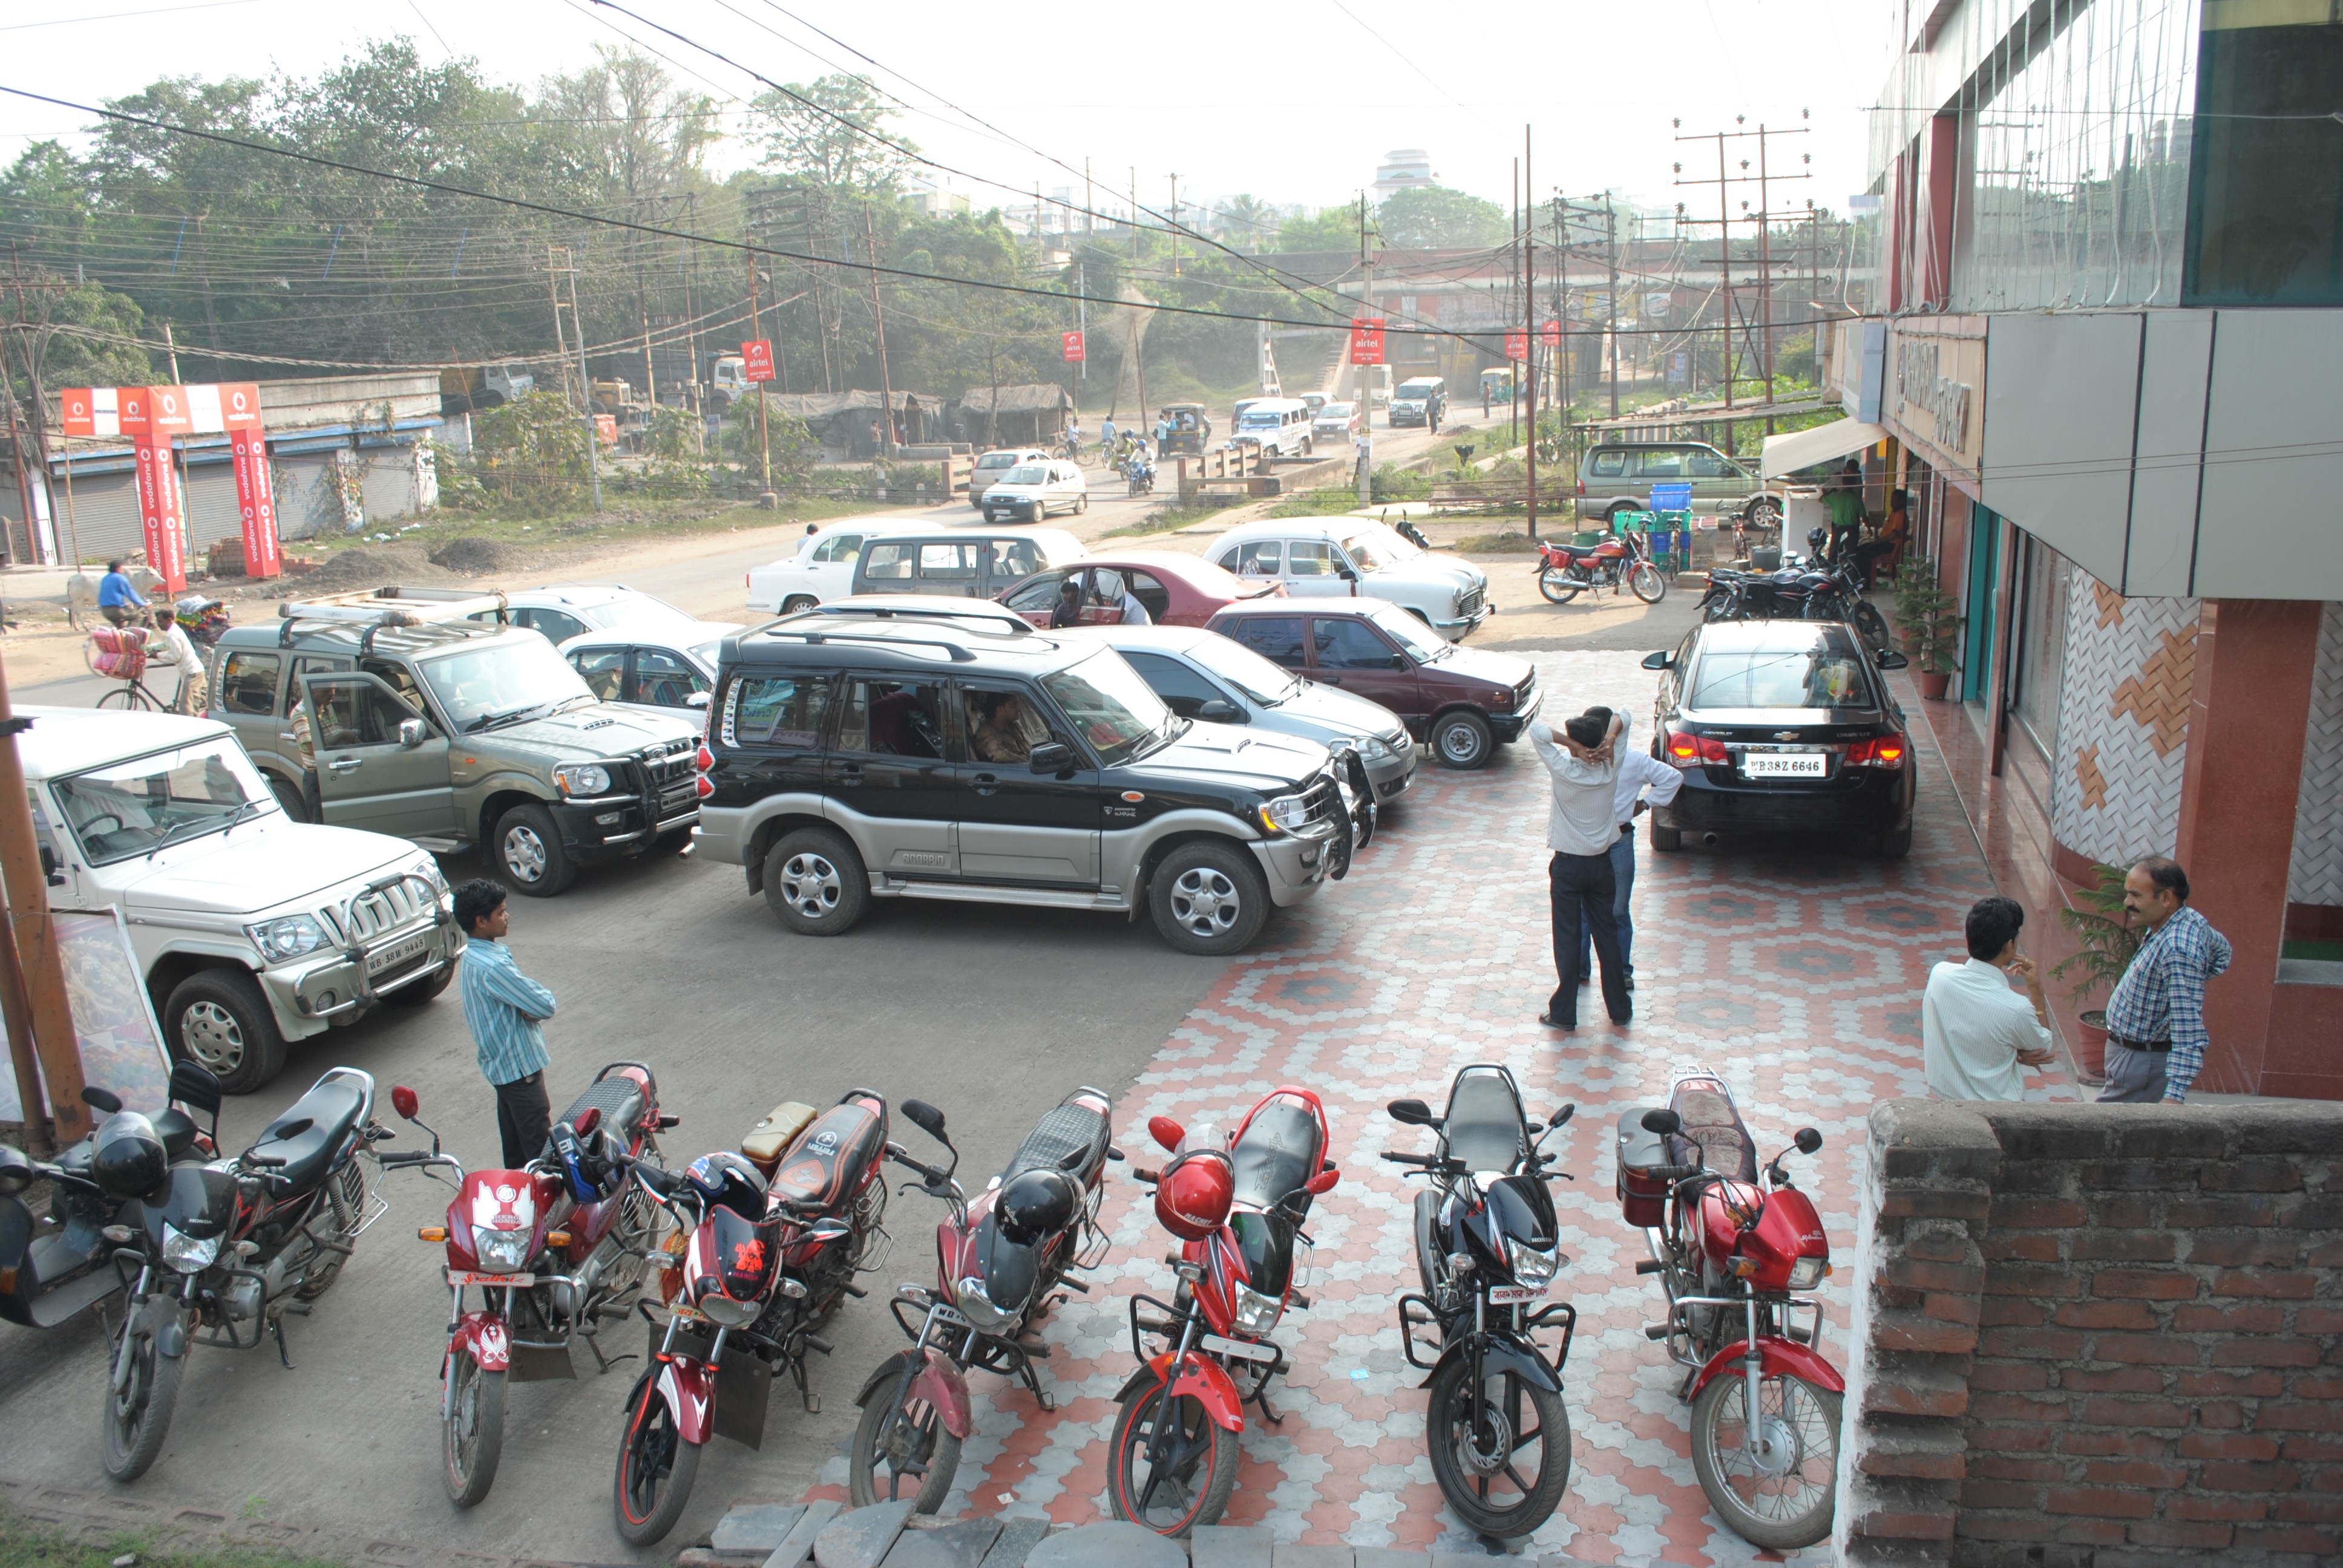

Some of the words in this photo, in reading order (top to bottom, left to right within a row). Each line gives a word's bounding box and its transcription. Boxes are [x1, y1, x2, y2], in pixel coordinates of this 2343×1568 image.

[749, 358, 769, 368] airtel
[1355, 338, 1378, 348] airtel
[228, 413, 255, 422] vodafone
[145, 463, 155, 509] vodafone
[163, 463, 173, 510] vodafone
[240, 456, 251, 500] vodafone
[170, 531, 180, 577] vodafone
[247, 520, 258, 563] vodafone
[264, 518, 274, 561] vodafone
[1792, 760, 1820, 771] 6646
[903, 853, 945, 866] SCORPIO
